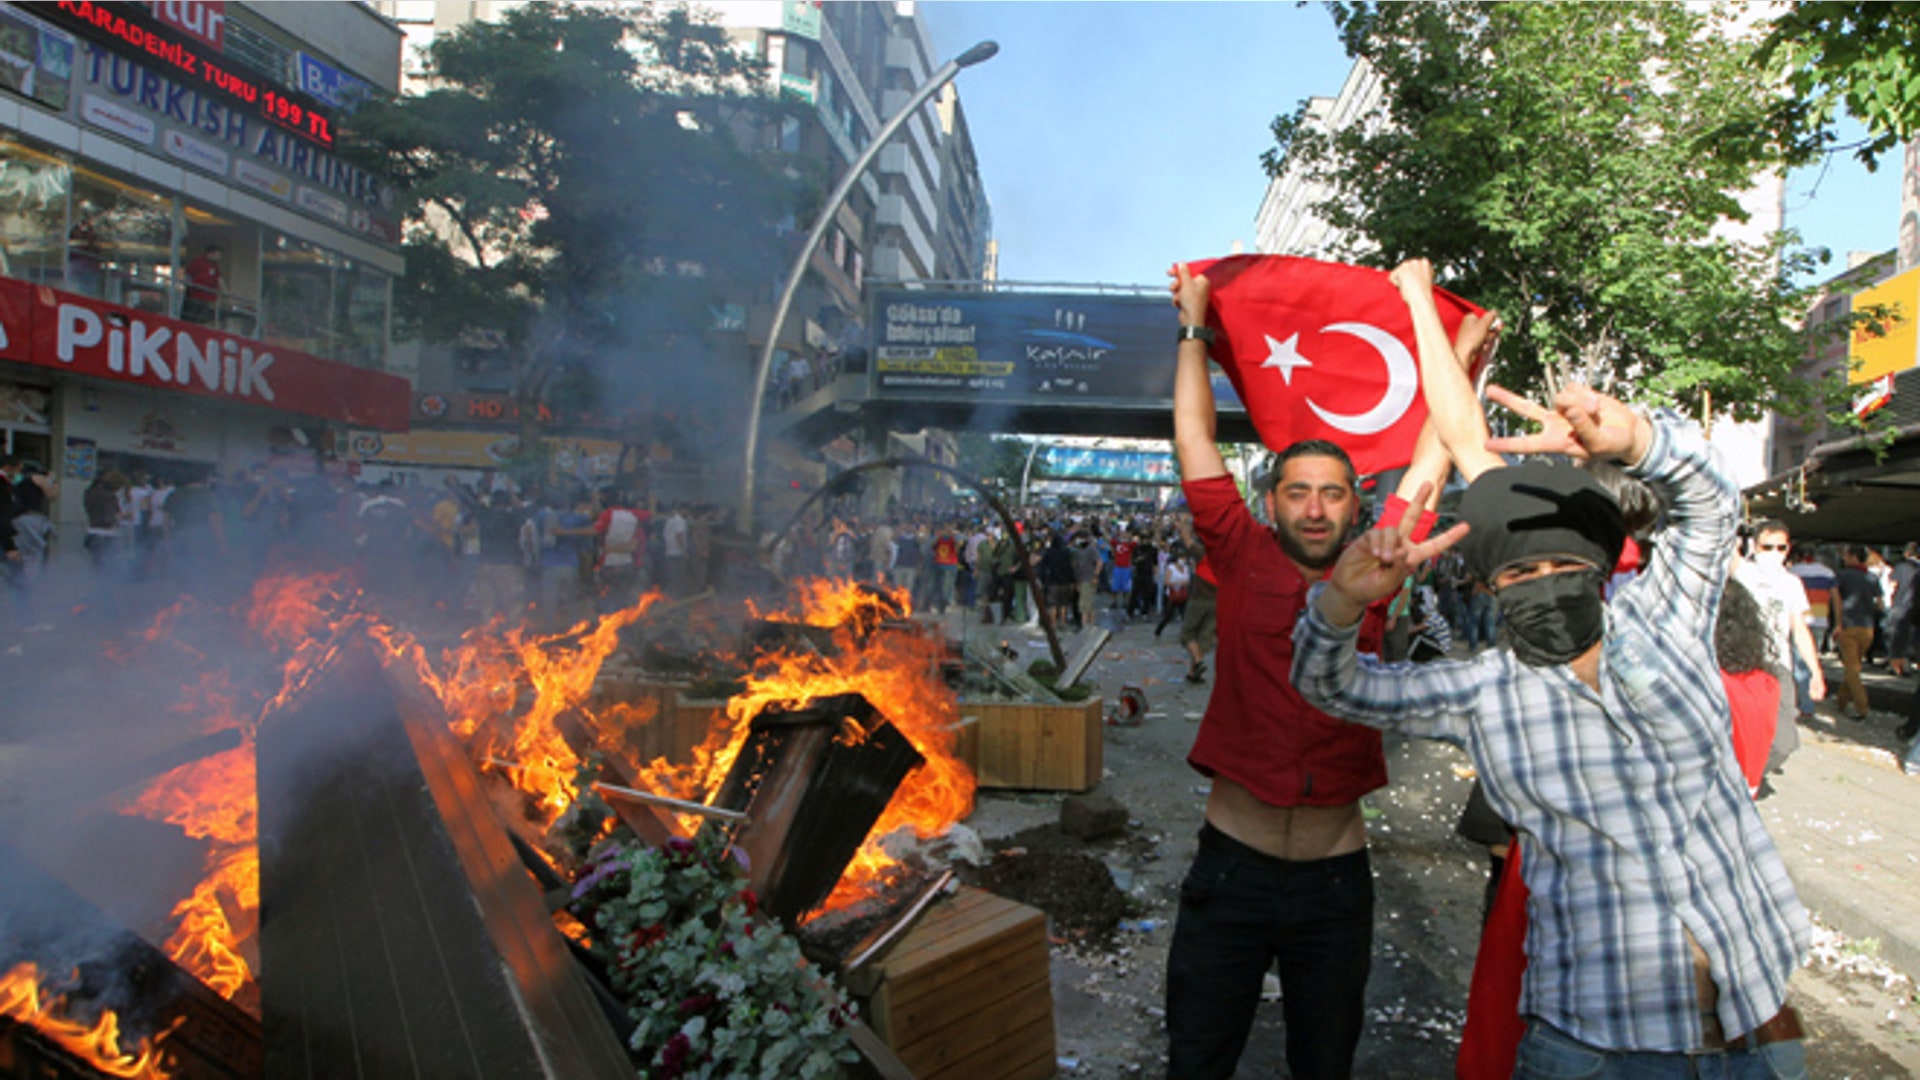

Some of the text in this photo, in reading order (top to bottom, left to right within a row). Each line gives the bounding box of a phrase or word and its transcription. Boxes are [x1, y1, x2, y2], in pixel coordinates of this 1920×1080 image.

[85, 42, 246, 147] TURKISH
[255, 126, 379, 206] AIRLINES
[203, 61, 257, 103] TURU
[263, 91, 303, 126] 199
[306, 110, 333, 143] TL
